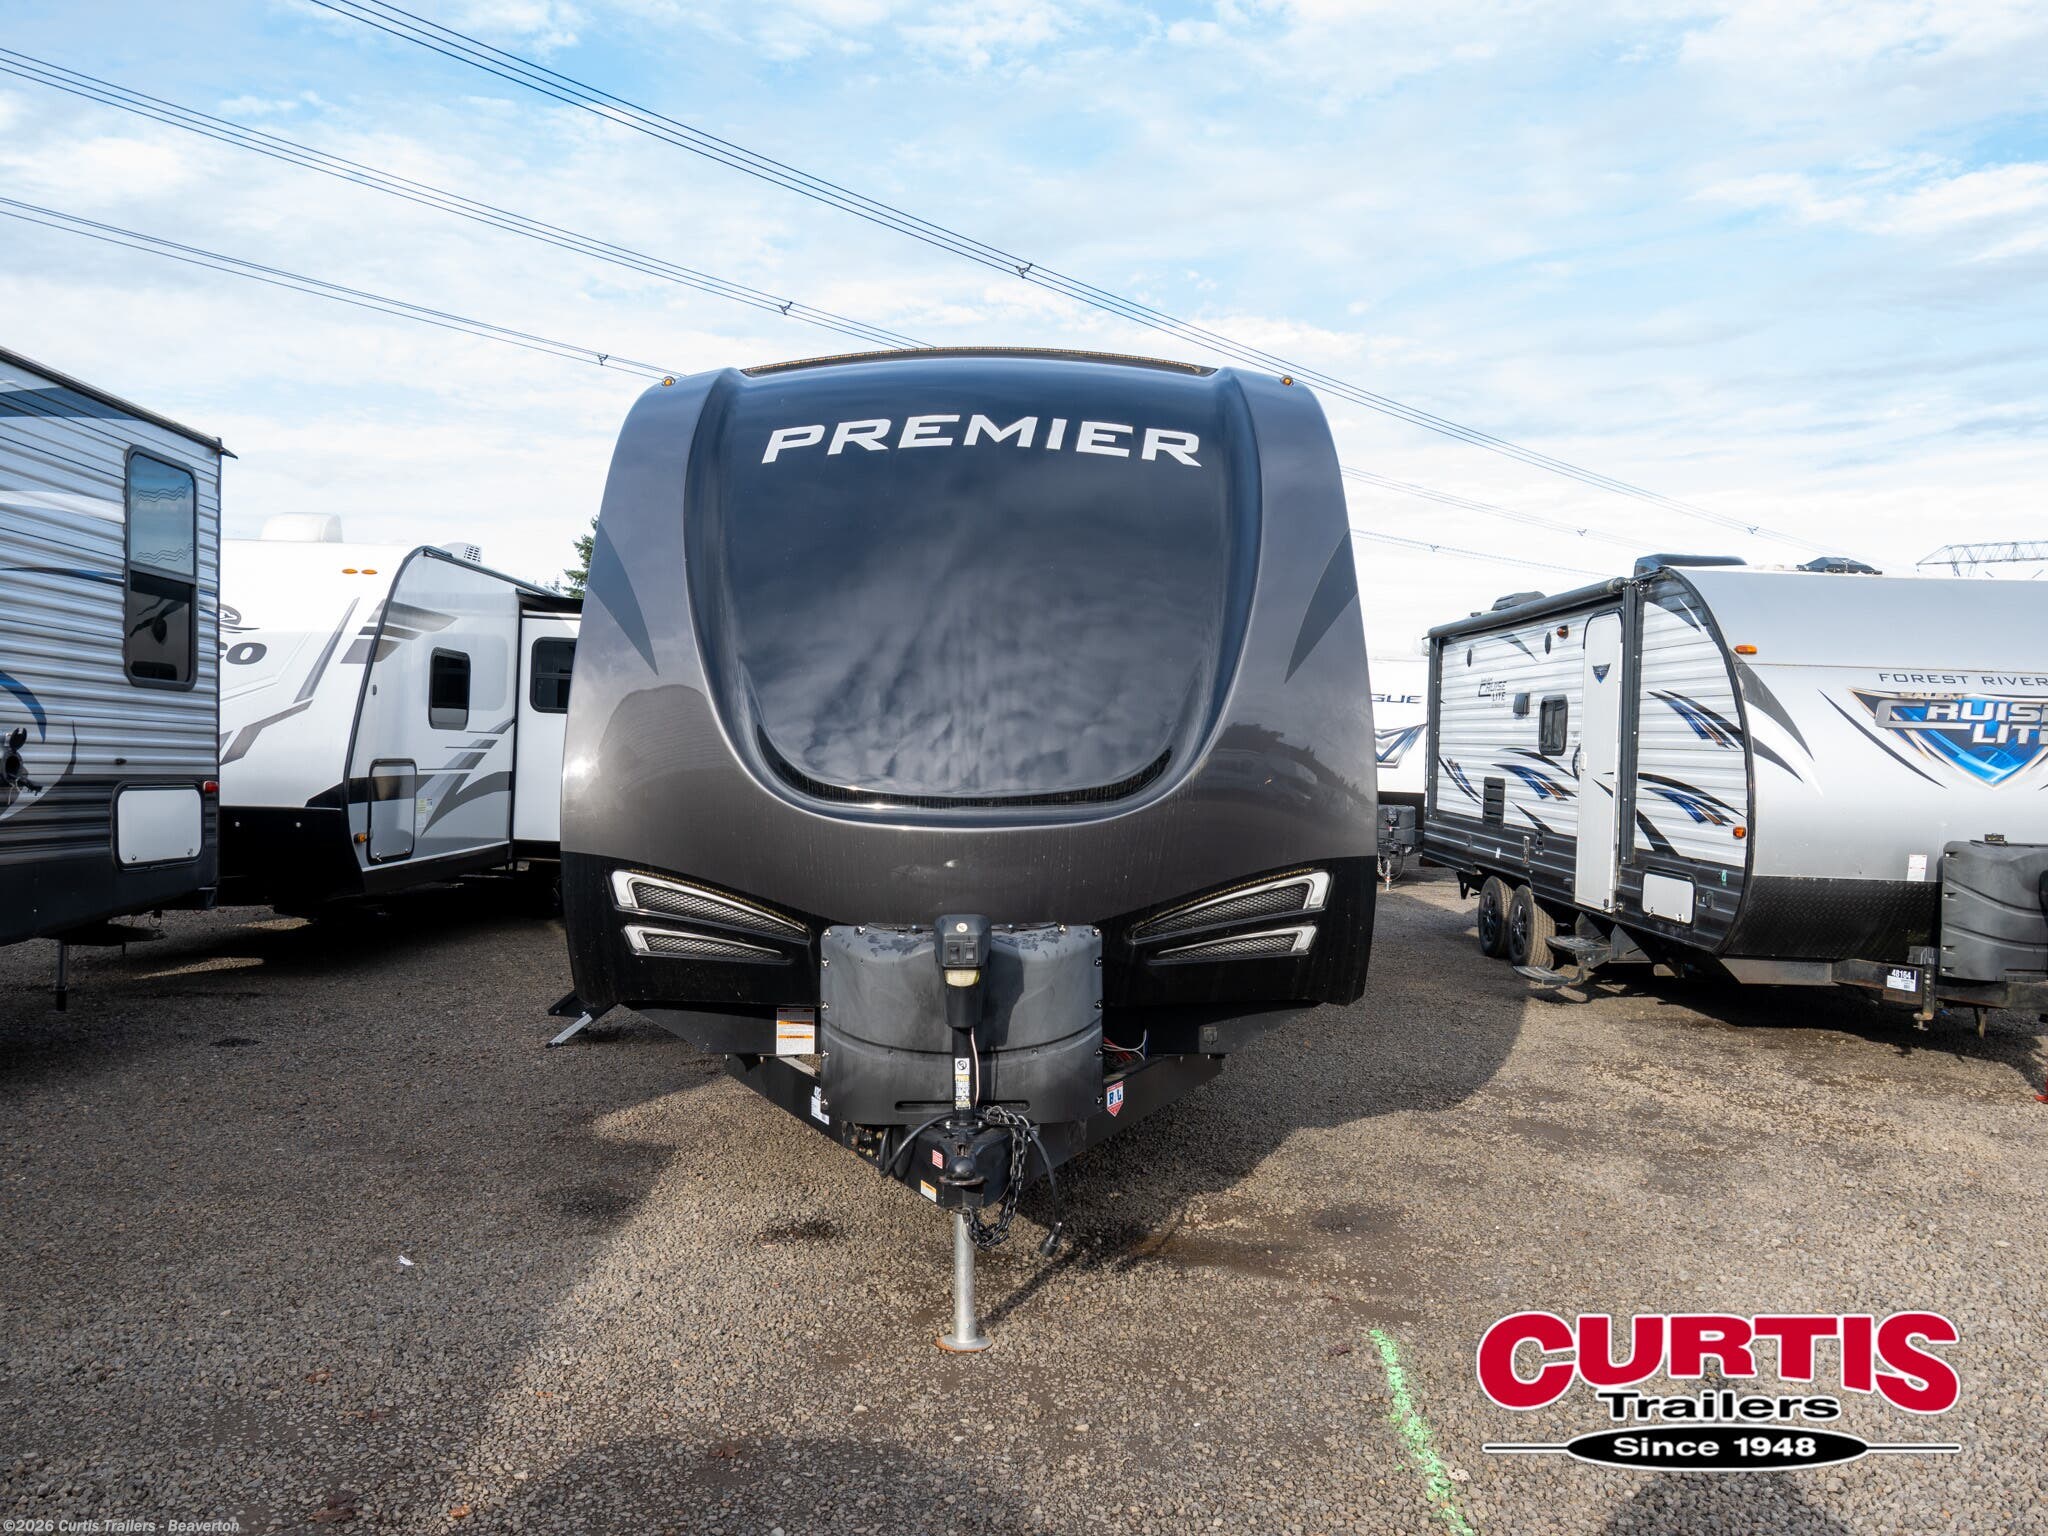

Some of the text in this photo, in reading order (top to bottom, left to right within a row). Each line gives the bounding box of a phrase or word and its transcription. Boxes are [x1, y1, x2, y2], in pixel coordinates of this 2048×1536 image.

[761, 414, 1202, 467] PREMIER
[1878, 673, 1968, 685] FOREST
[1492, 691, 1506, 702] LITE
